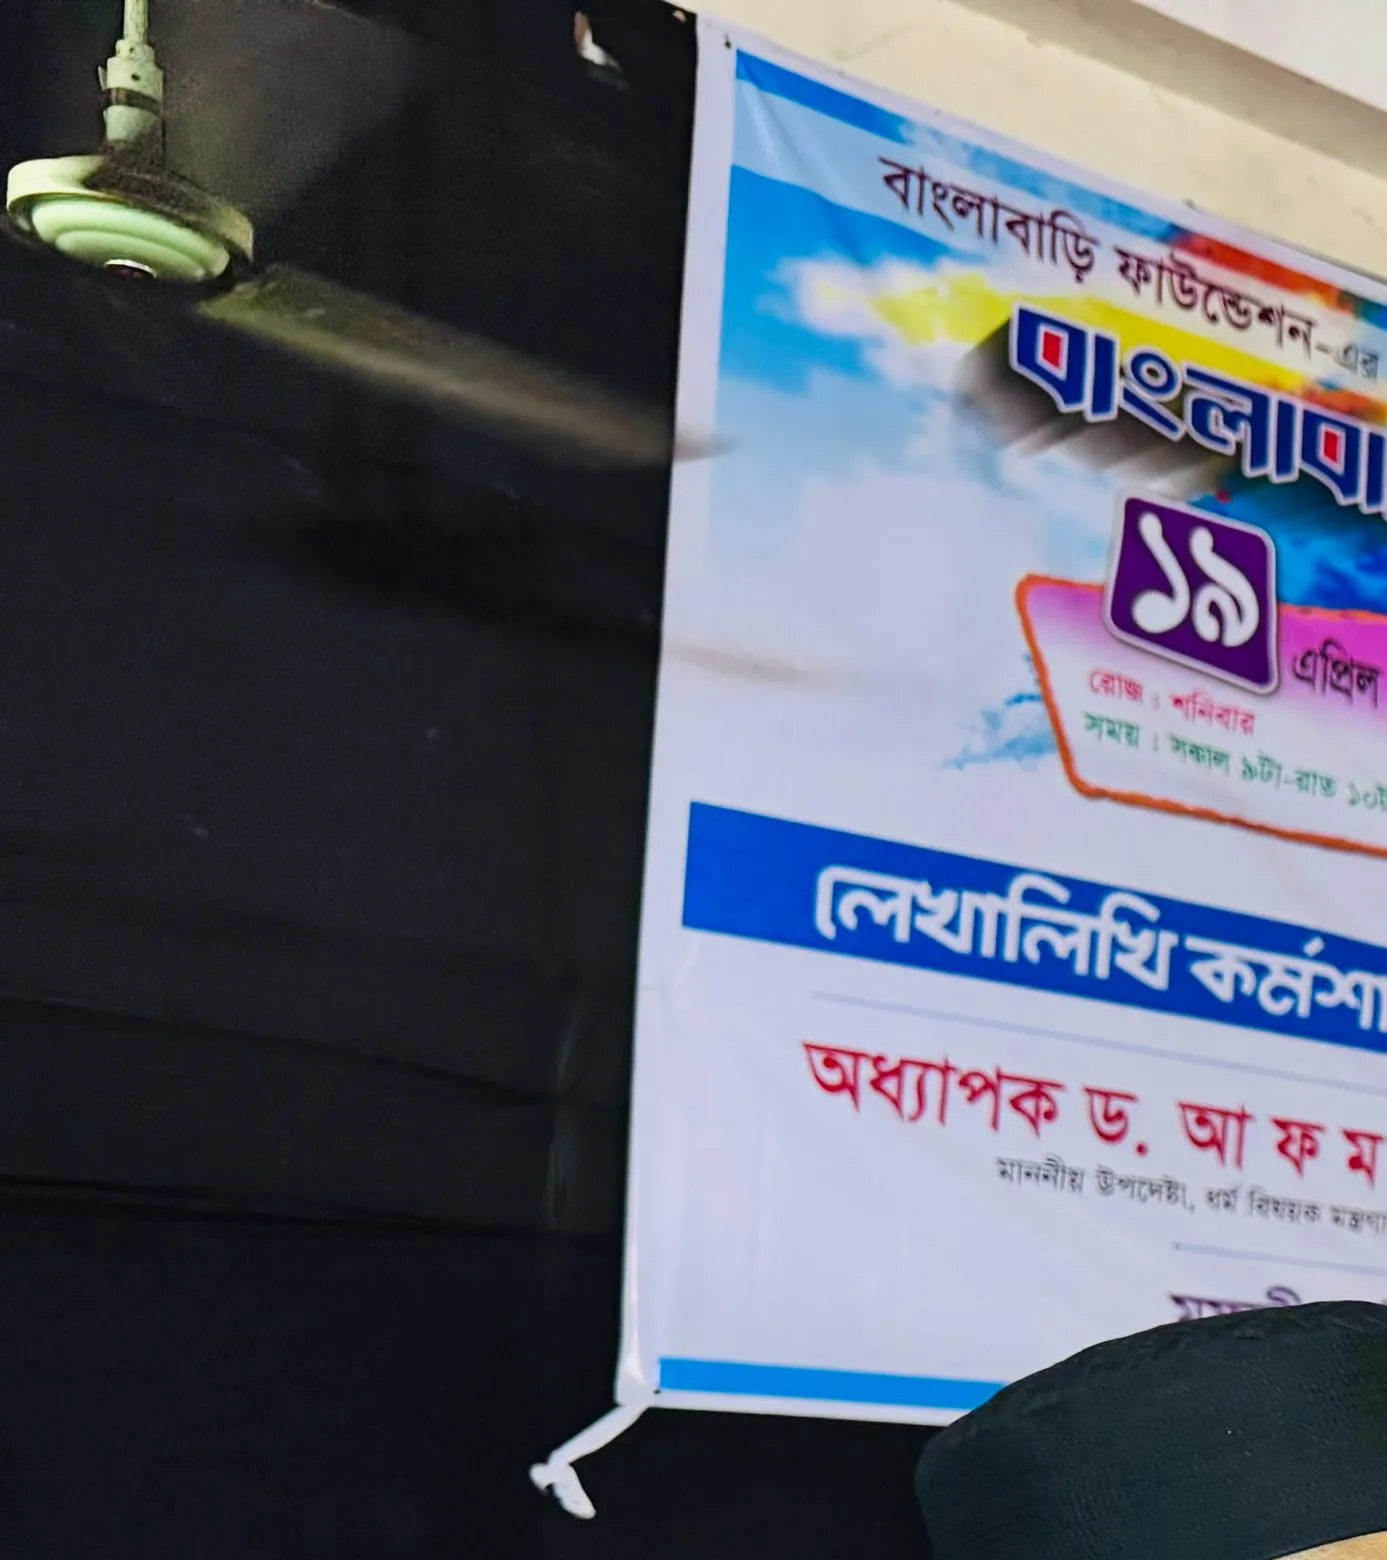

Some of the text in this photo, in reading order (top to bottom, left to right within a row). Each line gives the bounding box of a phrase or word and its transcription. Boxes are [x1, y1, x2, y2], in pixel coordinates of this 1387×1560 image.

[879, 155, 1099, 284] বাংলাবাড়ি
[1131, 510, 1260, 648] ১৯
[1169, 684, 1257, 735] শনিবার
[1293, 637, 1384, 710] এপ্রিল
[1083, 711, 1142, 749] সময়
[1169, 732, 1232, 777] সকাল
[814, 865, 1179, 991] লেখালিখি
[801, 1038, 1065, 1138] অধ্যাপক
[1083, 1085, 1150, 1159] ড.
[1178, 1101, 1255, 1170] আ
[1271, 1115, 1328, 1177] ফ
